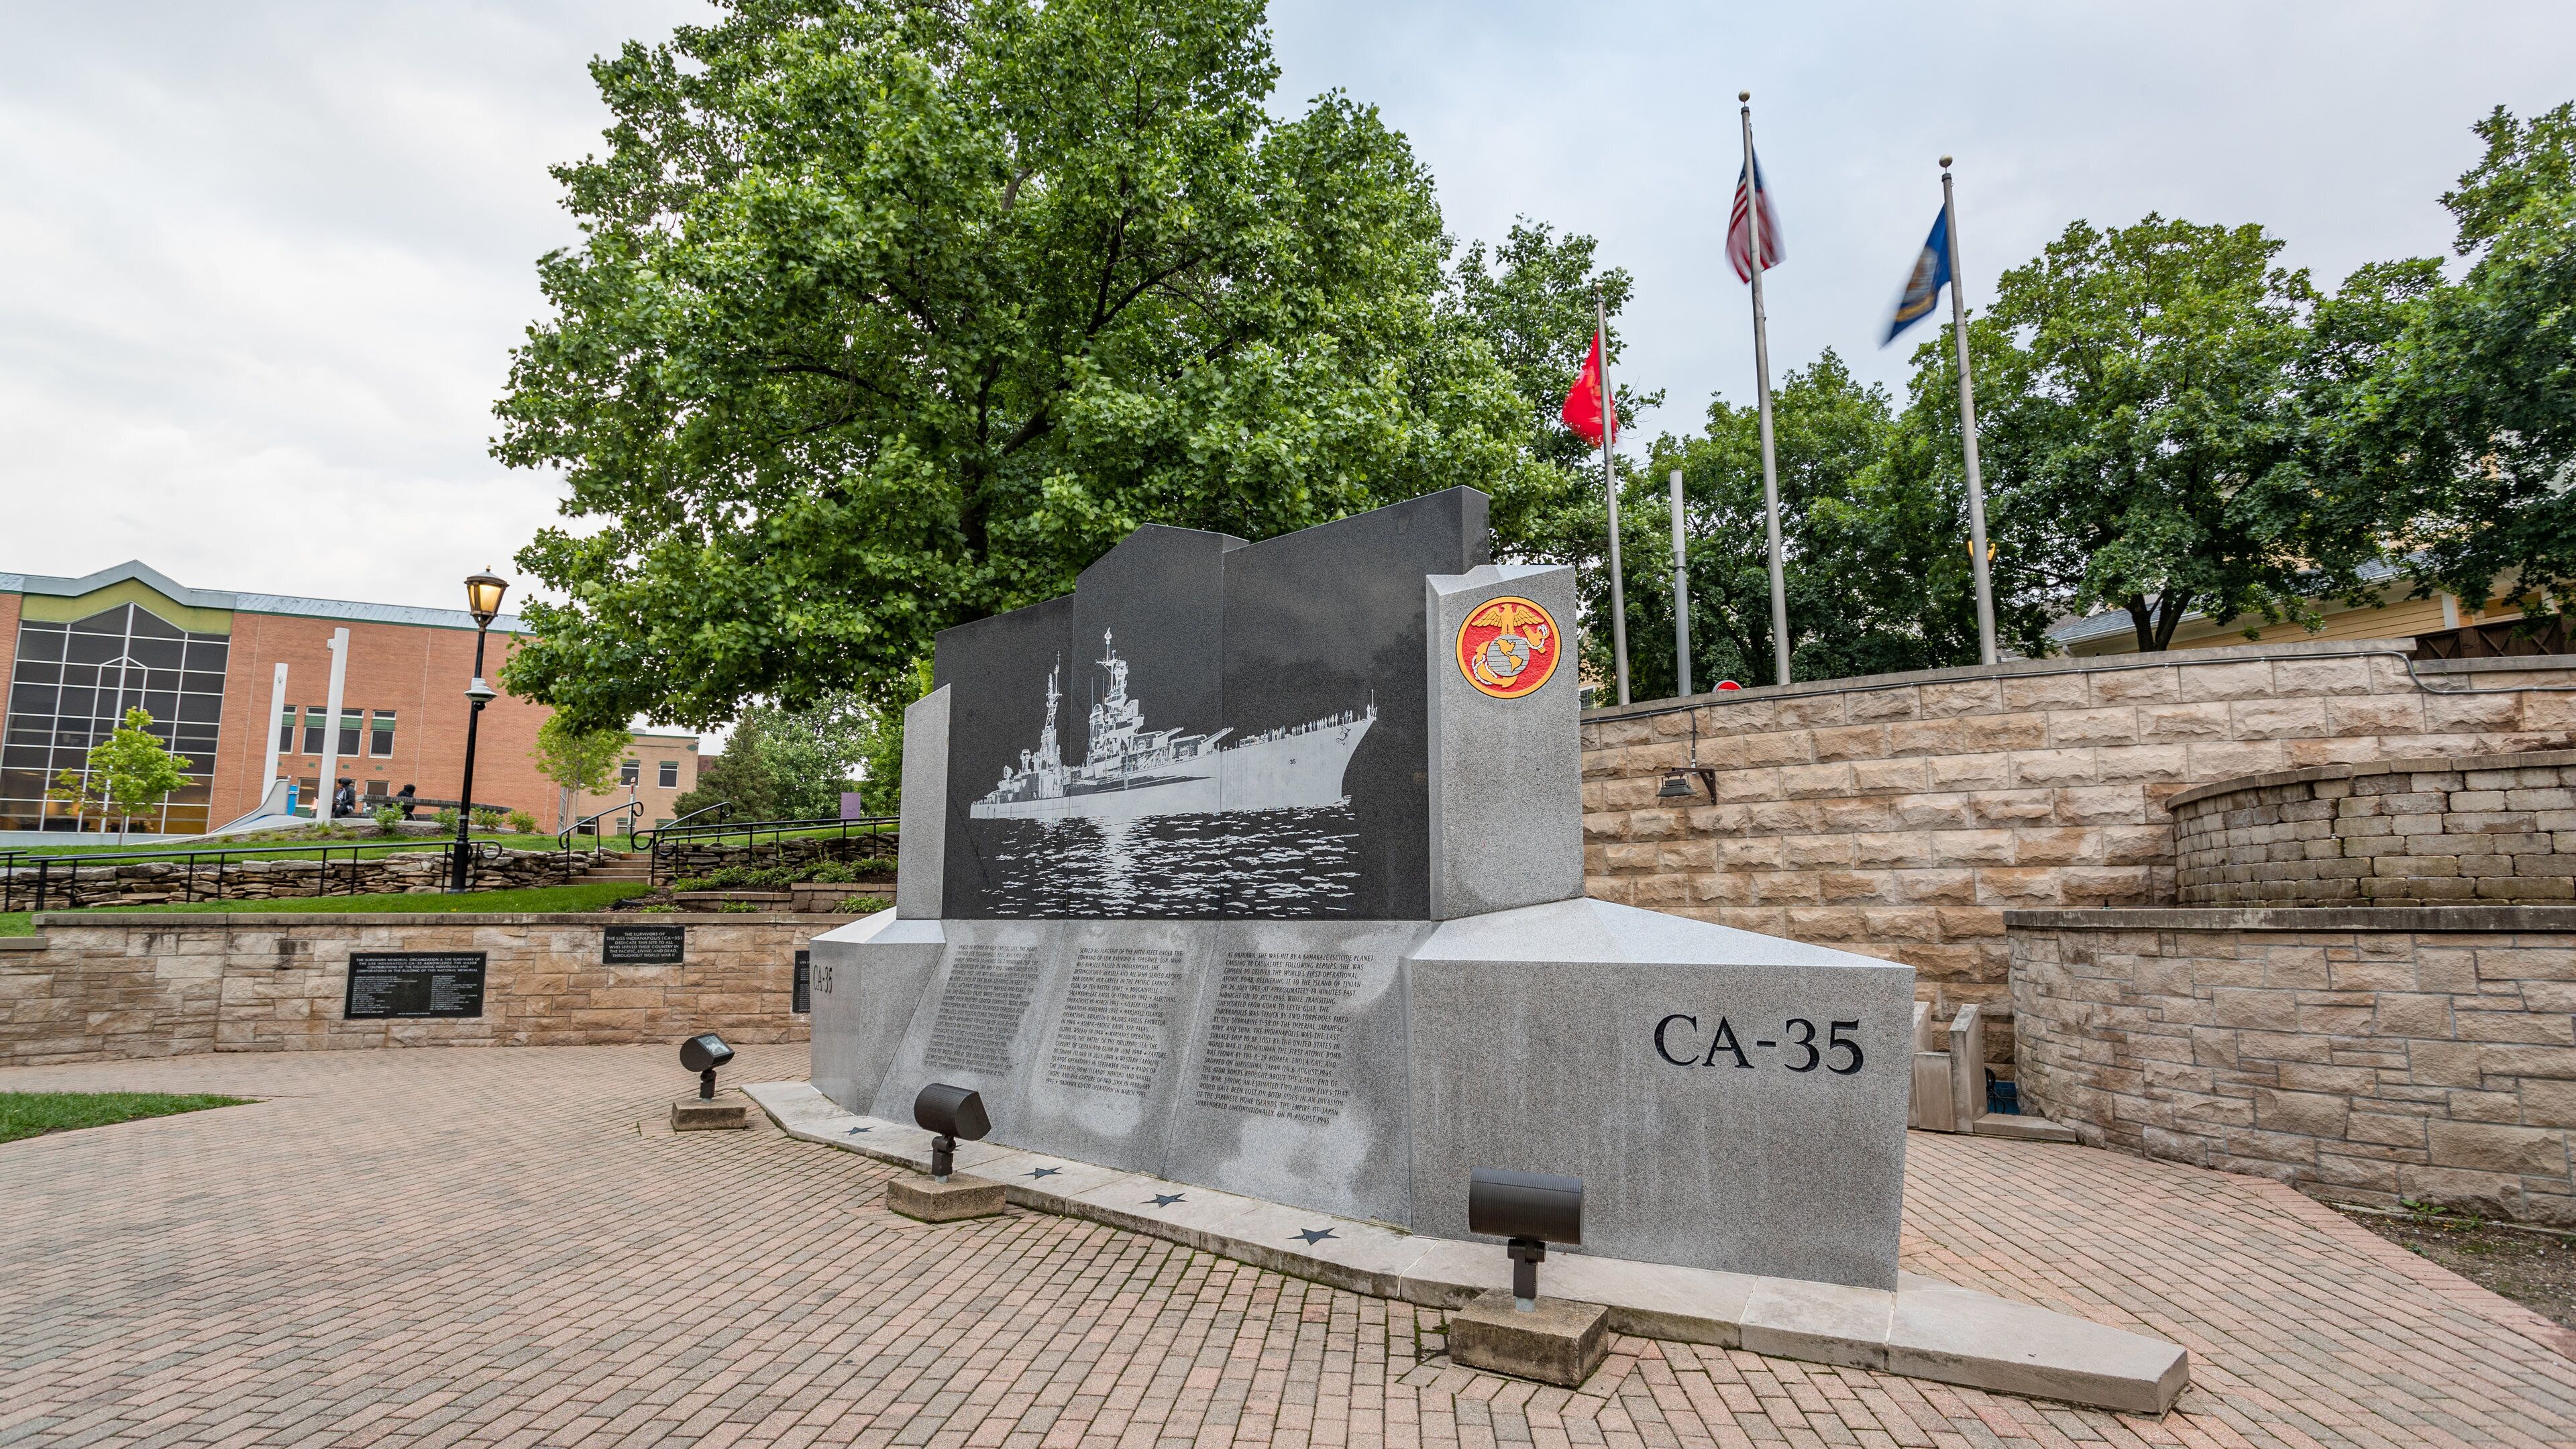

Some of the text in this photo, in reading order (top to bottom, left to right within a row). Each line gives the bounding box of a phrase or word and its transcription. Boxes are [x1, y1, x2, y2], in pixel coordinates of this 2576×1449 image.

[814, 965, 832, 994] CA-35
[1215, 1008, 1247, 1016] INDIANAPOLIS
[1302, 1013, 1331, 1022] TORPEDOES
[1333, 1015, 1348, 1023] FIRED
[1292, 1021, 1316, 1029] IMPERIAL
[1292, 1039, 1311, 1047] UNITED
[1313, 1040, 1333, 1049] STATES
[1654, 1014, 1864, 1075] CA-35
[1304, 1049, 1324, 1057] ATOMIC
[1291, 1057, 1309, 1065] ENOLA
[1296, 1067, 1319, 1075] AUGUST
[1299, 1076, 1317, 1084] EARLY
[1224, 1076, 1348, 1097] SAVING MILLION LIVES THAT
[1216, 1084, 1229, 1092] HAVE
[1230, 1086, 1243, 1094] BEEN
[1283, 1093, 1298, 1101] SIDES
[1317, 1097, 1344, 1107] INVASION
[1214, 1093, 1238, 1102] JAPANESE
[1239, 1096, 1254, 1104] HOME
[1291, 1103, 1310, 1112] EMPIRE
[1321, 1107, 1339, 1116] JAPAN
